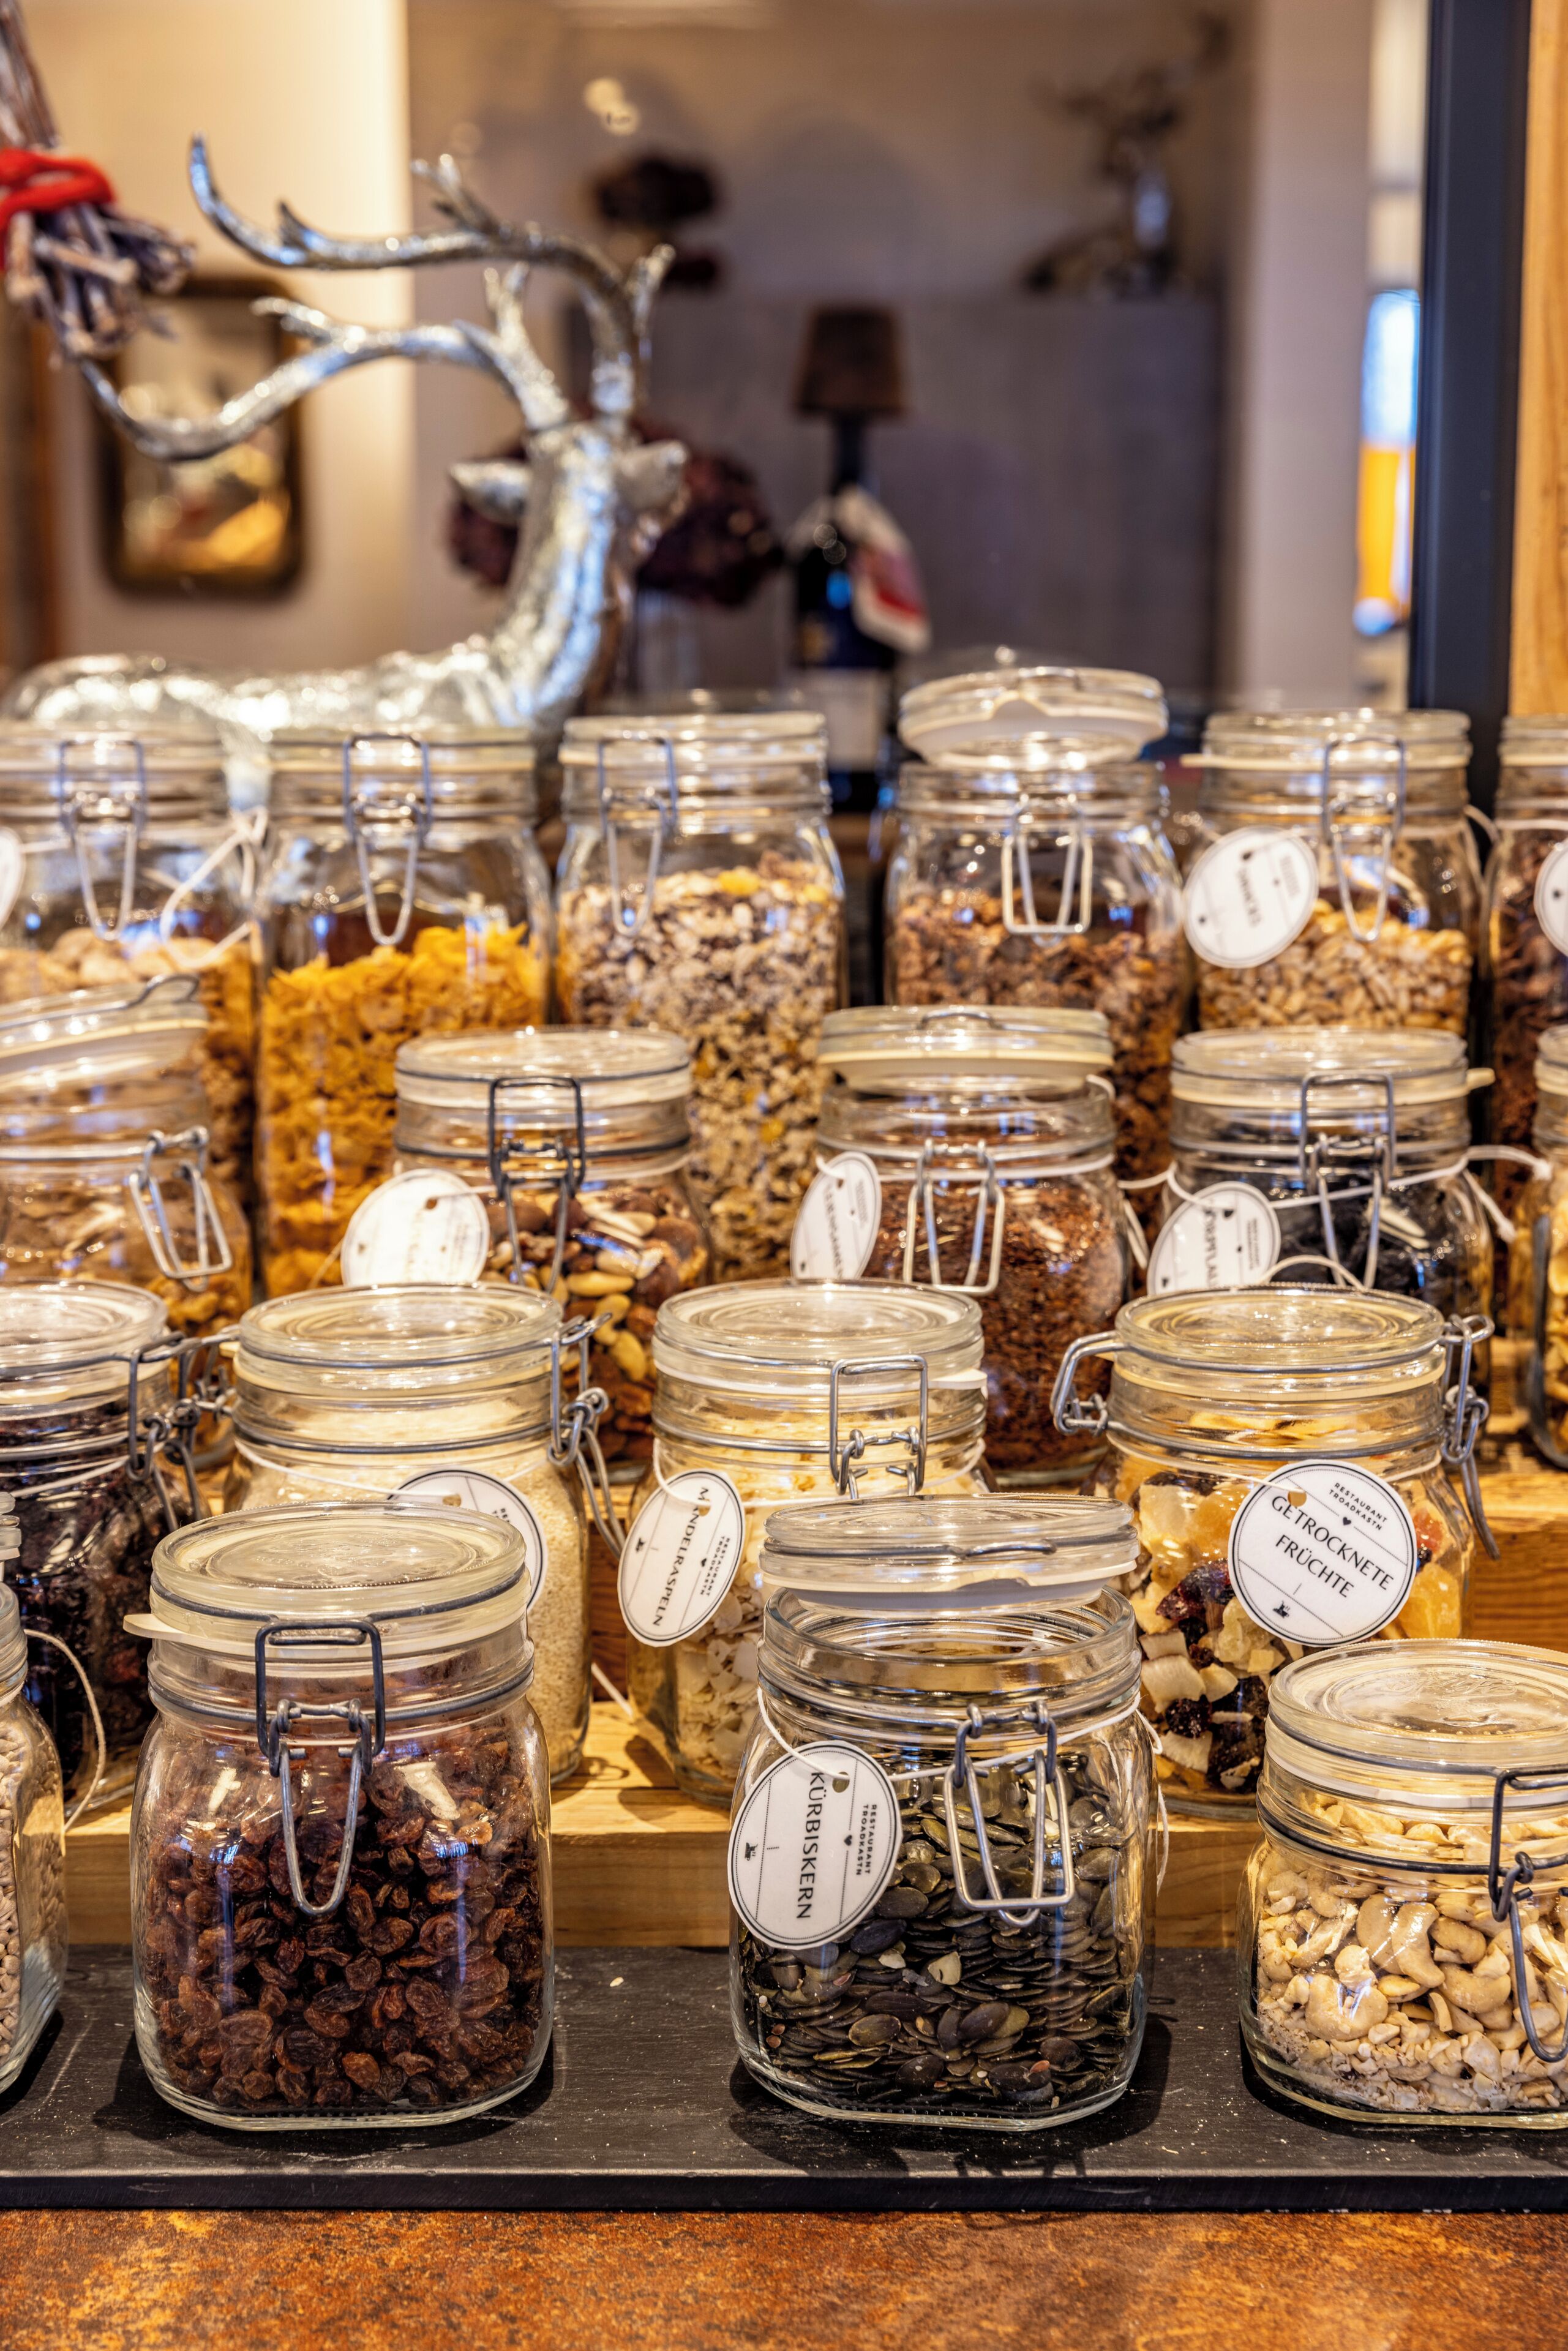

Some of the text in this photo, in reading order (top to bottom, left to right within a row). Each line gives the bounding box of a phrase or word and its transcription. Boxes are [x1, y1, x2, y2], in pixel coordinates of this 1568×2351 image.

[1329, 1488, 1382, 1531] TROADKASTN
[1334, 1482, 1387, 1523] RESTAURANT
[705, 1537, 730, 1596] RESTAURANT
[1271, 1496, 1394, 1591] GETROCKNETE
[1275, 1534, 1354, 1598] FRÜCHTE
[796, 1772, 827, 1919] KÜRBISKERN
[855, 1804, 869, 1876] TROADKASTN
[864, 1804, 877, 1875] RESTAURANT
